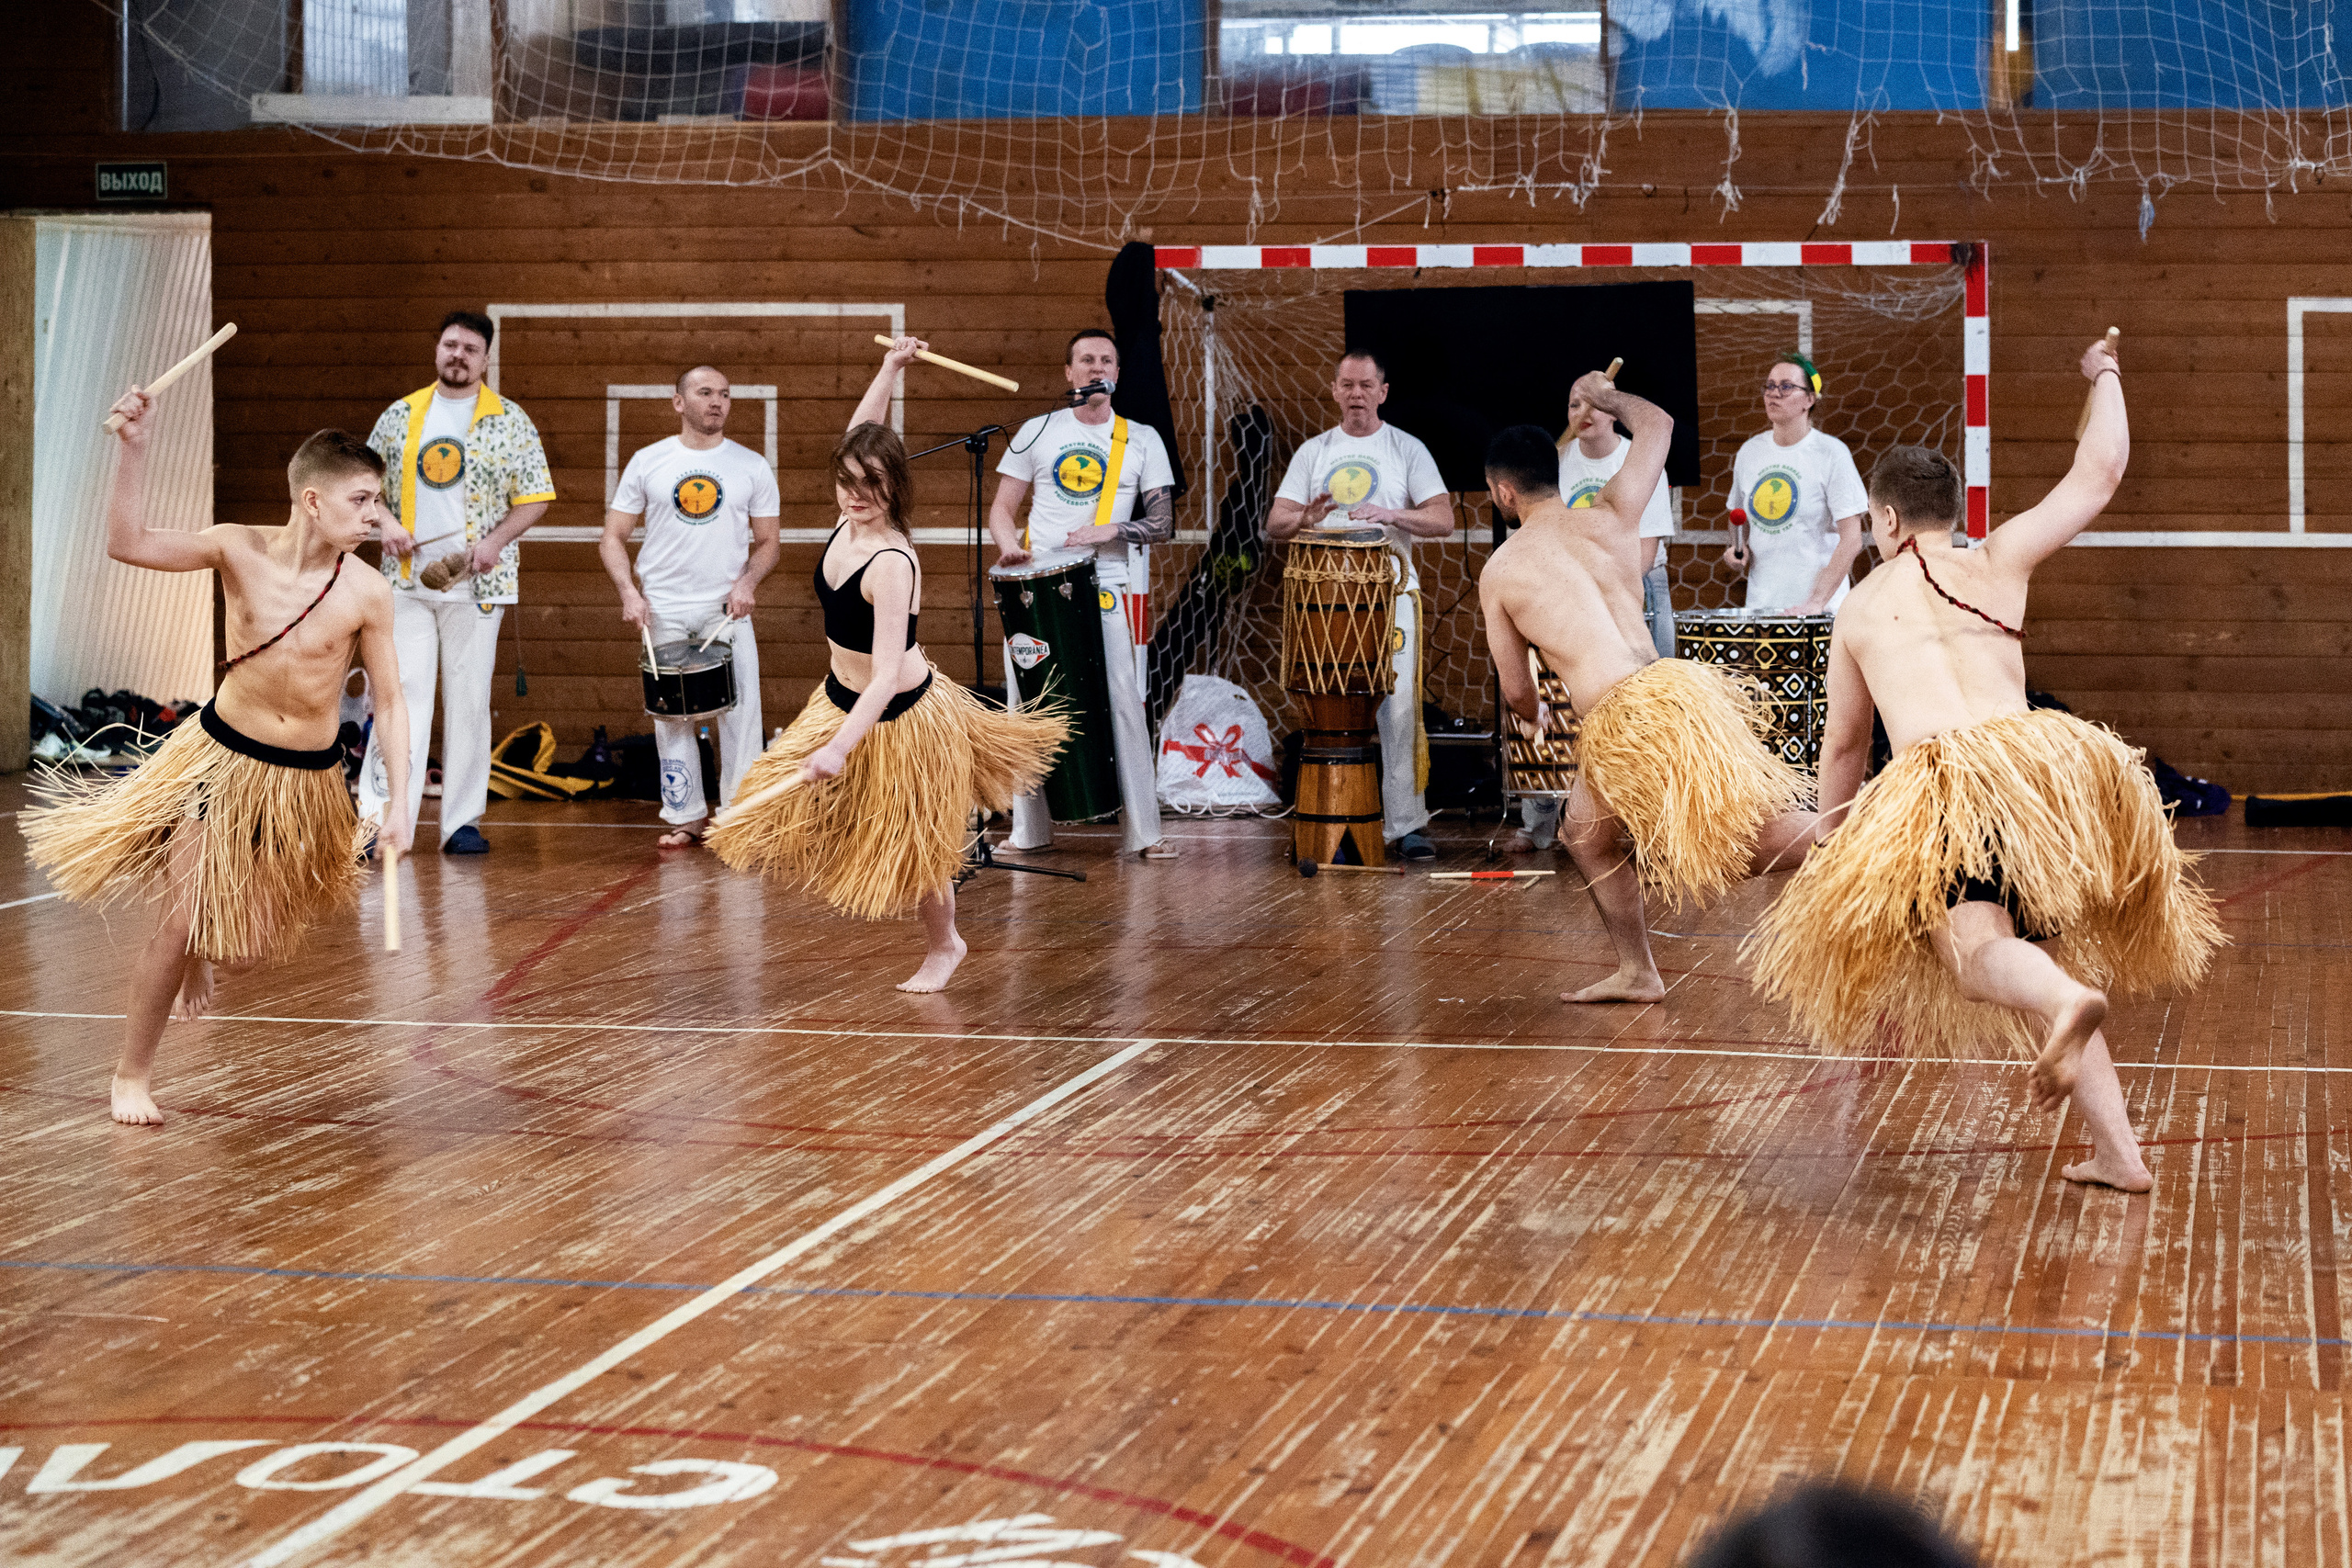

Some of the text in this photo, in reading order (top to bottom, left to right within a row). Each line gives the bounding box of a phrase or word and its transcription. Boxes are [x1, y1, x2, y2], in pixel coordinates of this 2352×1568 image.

[99, 171, 164, 194] ВЫХОД
[1059, 442, 1085, 451] MESTRE
[1055, 491, 1089, 506] PROFESSOR
[0, 1438, 779, 1510] СТОЛ
